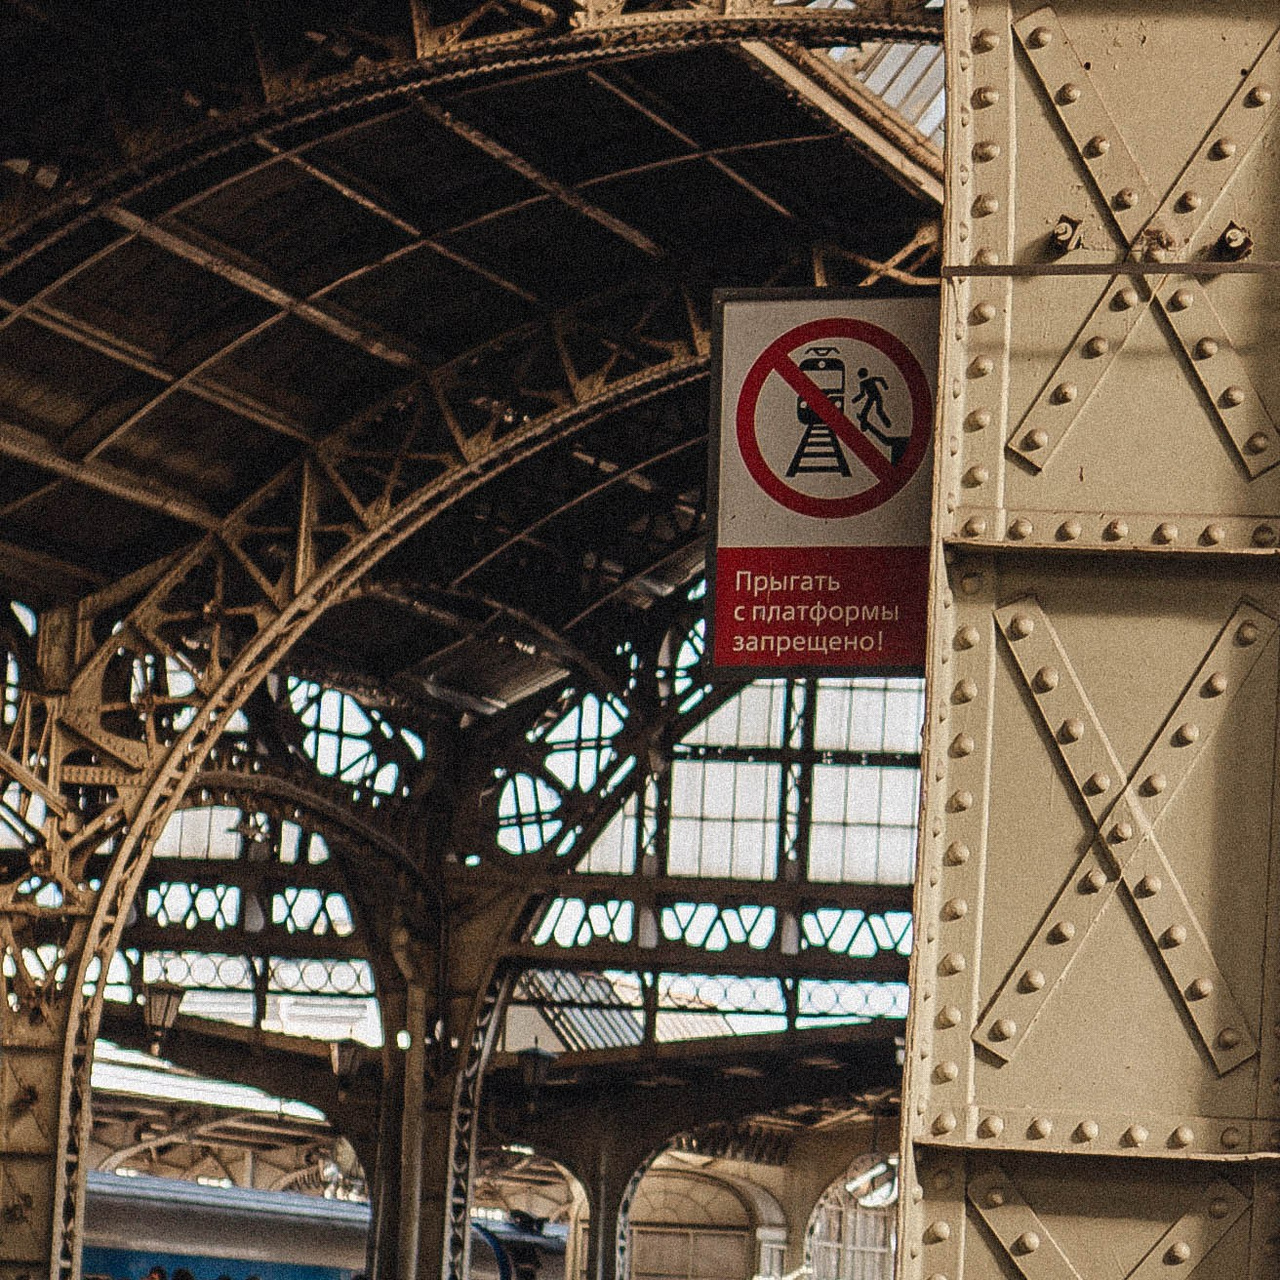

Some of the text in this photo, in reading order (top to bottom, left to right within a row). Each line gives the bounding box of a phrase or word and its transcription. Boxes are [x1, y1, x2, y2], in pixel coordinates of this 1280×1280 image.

[735, 571, 840, 596] Прыгать
[734, 601, 899, 626] с платформы
[732, 631, 883, 656] запрещено!
